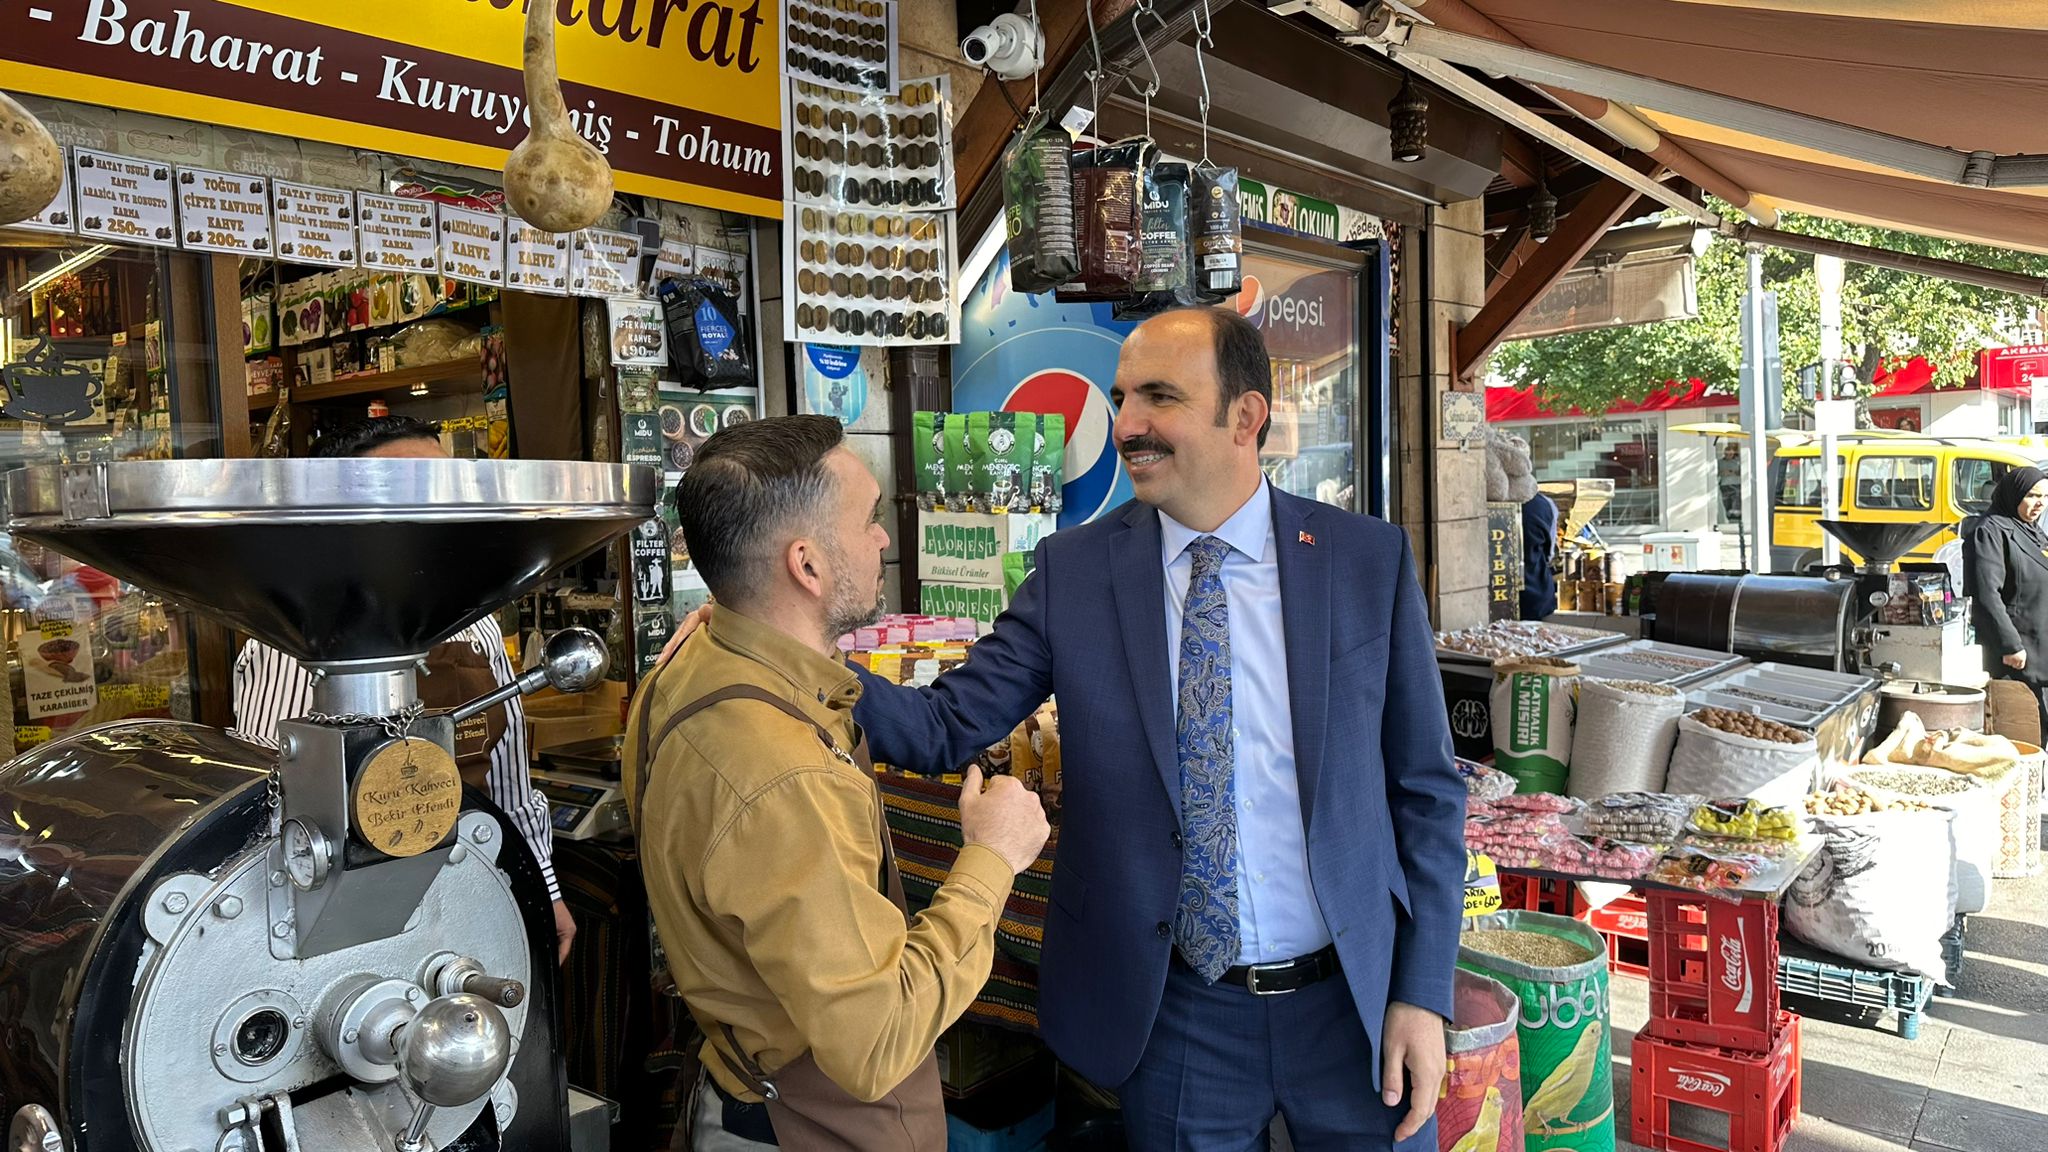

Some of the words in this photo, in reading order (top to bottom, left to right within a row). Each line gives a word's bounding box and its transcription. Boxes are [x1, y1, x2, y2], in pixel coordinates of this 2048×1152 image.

[77, 0, 325, 87] Baharat
[375, 54, 614, 154] Kuruyiş
[653, 114, 772, 177] Tohum
[96, 159, 122, 173] HATAY
[126, 165, 150, 177] USULÜ
[111, 176, 138, 189] KAHVE
[203, 176, 241, 194] YOĞUN
[83, 187, 116, 201] ARABİCA
[119, 192, 130, 203] VE
[184, 192, 216, 210] ÇİFTE
[280, 187, 311, 200] HATAY
[315, 192, 345, 204] USULÜ
[113, 206, 140, 219] KARMA
[297, 203, 330, 215] KAHVE
[364, 198, 394, 210] HATAY
[398, 203, 427, 214] USULÜ
[1143, 200, 1169, 210] MIDU
[207, 216, 245, 232] KAHVE
[380, 213, 412, 225] KAHVE
[1293, 205, 1335, 240] LOKUM
[298, 230, 331, 241] KARMA
[452, 219, 490, 240] AMERİCANO
[1140, 231, 1177, 240] COFFEE
[382, 239, 413, 250] KARMA
[452, 241, 491, 261] KAHVE
[518, 250, 555, 269] KAHVE
[701, 306, 717, 321] 10
[1269, 295, 1323, 331] pepsi
[628, 333, 652, 344] KAHVE
[634, 429, 653, 437] MIDU
[626, 454, 662, 462] ESPRESSO
[636, 539, 664, 548] FILTER
[927, 538, 995, 554] FLOREST
[635, 548, 666, 557] COFFEE
[931, 565, 959, 577] Bitkisel
[959, 565, 990, 579] Ürünler
[1491, 529, 1508, 602] DİBEK
[925, 600, 1000, 617] FLOREST
[647, 628, 666, 638] MIDU
[31, 691, 52, 702] TAZE
[55, 684, 95, 699] ÇEKİLMİŞ
[40, 698, 88, 713] KARABİBER
[1516, 690, 1530, 746] MISIRI
[362, 790, 401, 805] Kuru
[405, 776, 457, 797] Kahveci
[367, 809, 406, 827] Bekir
[411, 798, 455, 815] Efendi
